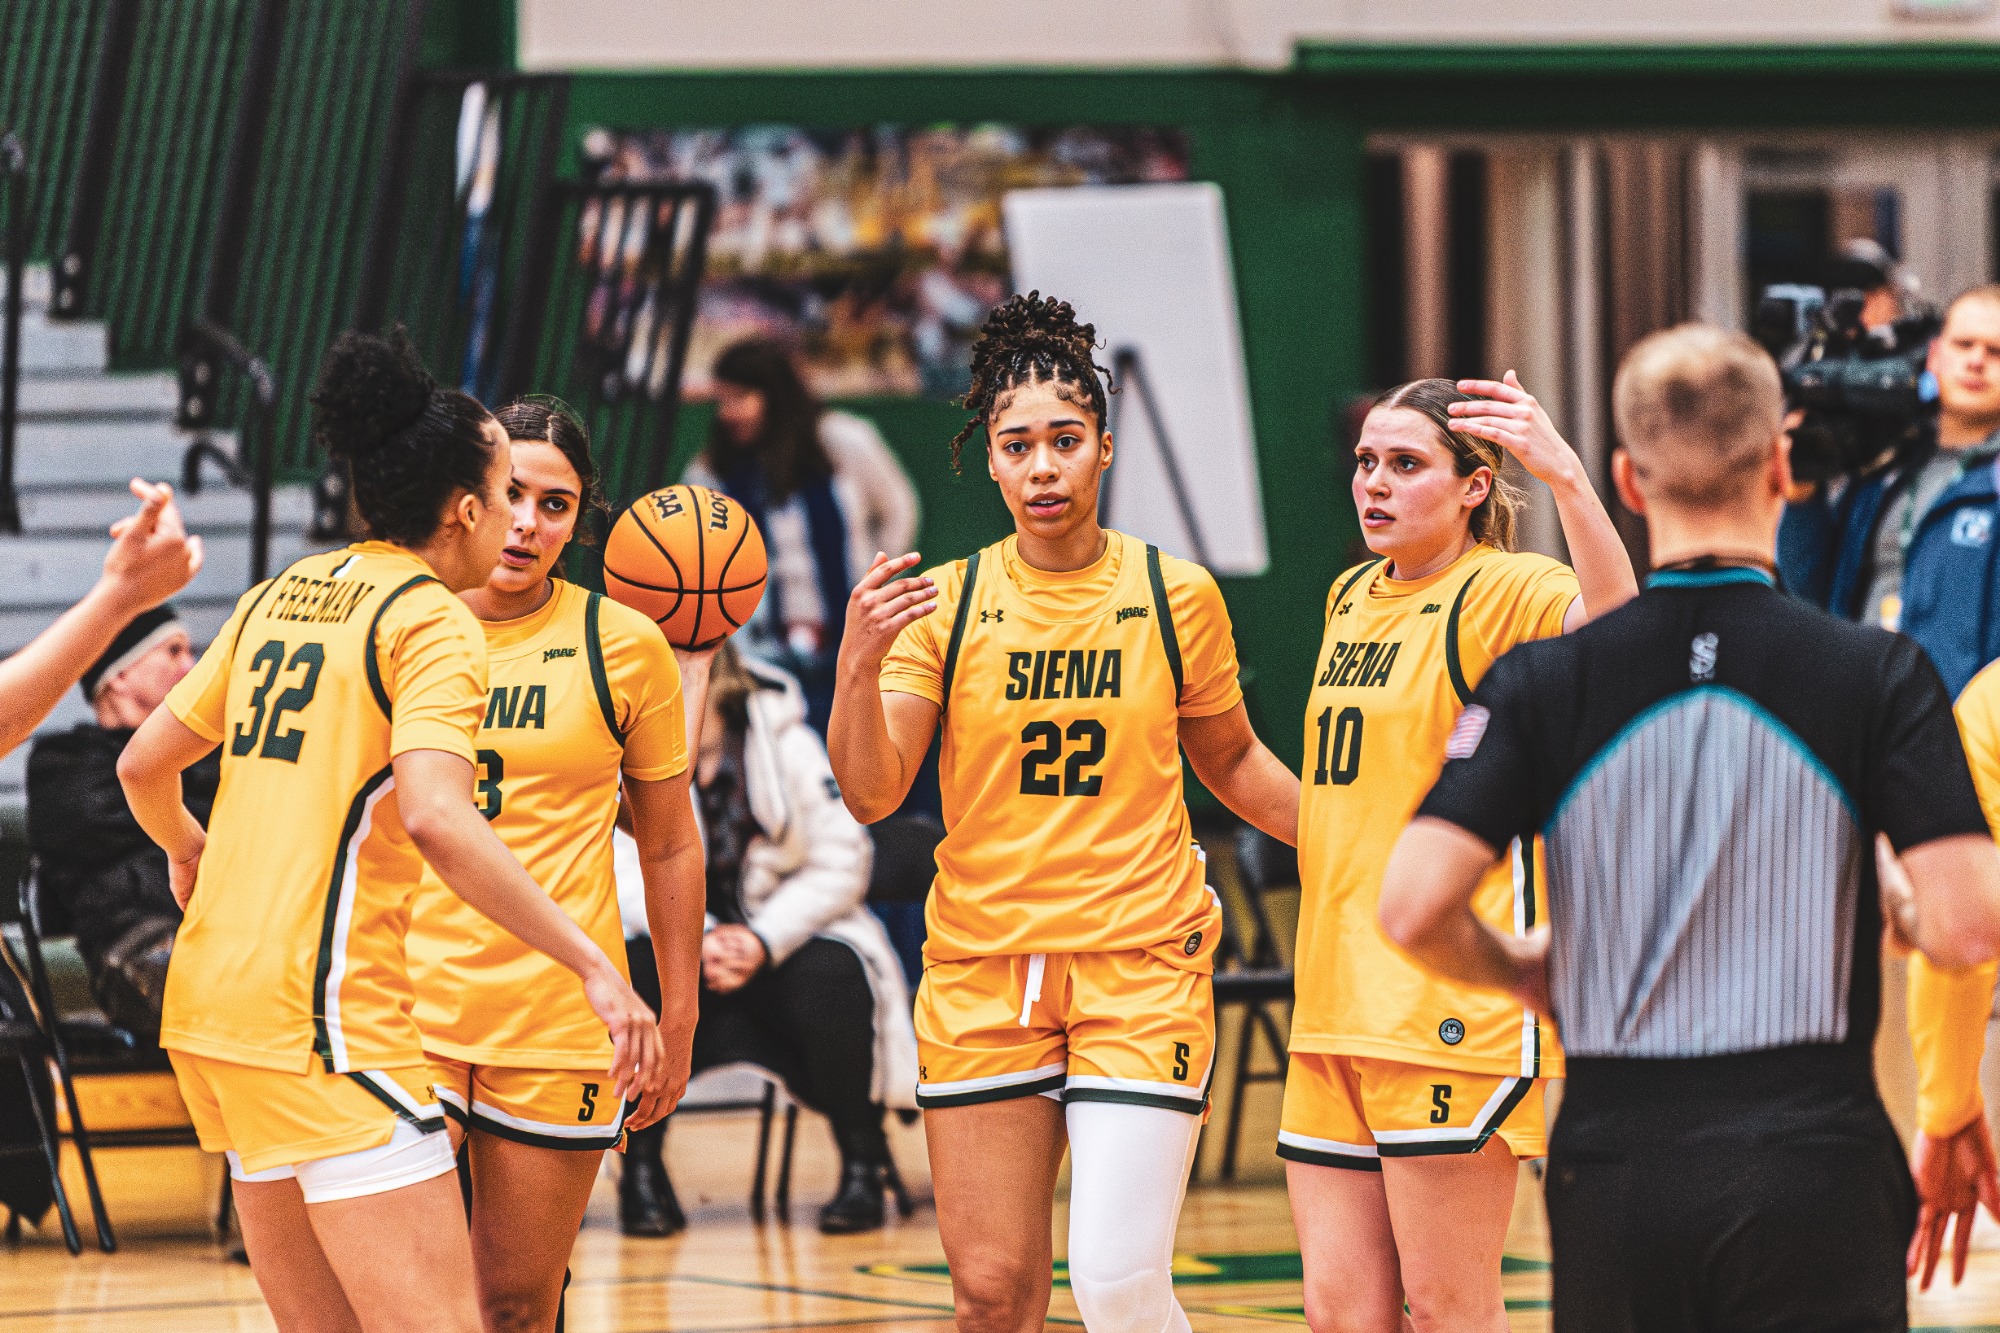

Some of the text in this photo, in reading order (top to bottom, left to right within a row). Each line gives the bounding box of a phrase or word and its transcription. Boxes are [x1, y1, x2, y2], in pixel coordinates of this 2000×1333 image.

[266, 575, 375, 624] FREEMAN
[1116, 607, 1149, 624] MAAC
[543, 648, 577, 663] MAAC
[1005, 649, 1122, 701] SIENA
[1318, 641, 1402, 687] SIENA
[230, 640, 325, 765] 32
[1019, 719, 1106, 797] 22
[1314, 706, 1364, 786] 10
[474, 749, 504, 822] 3
[1173, 1041, 1190, 1081] S
[578, 1083, 599, 1122] S
[1430, 1084, 1452, 1124] S
